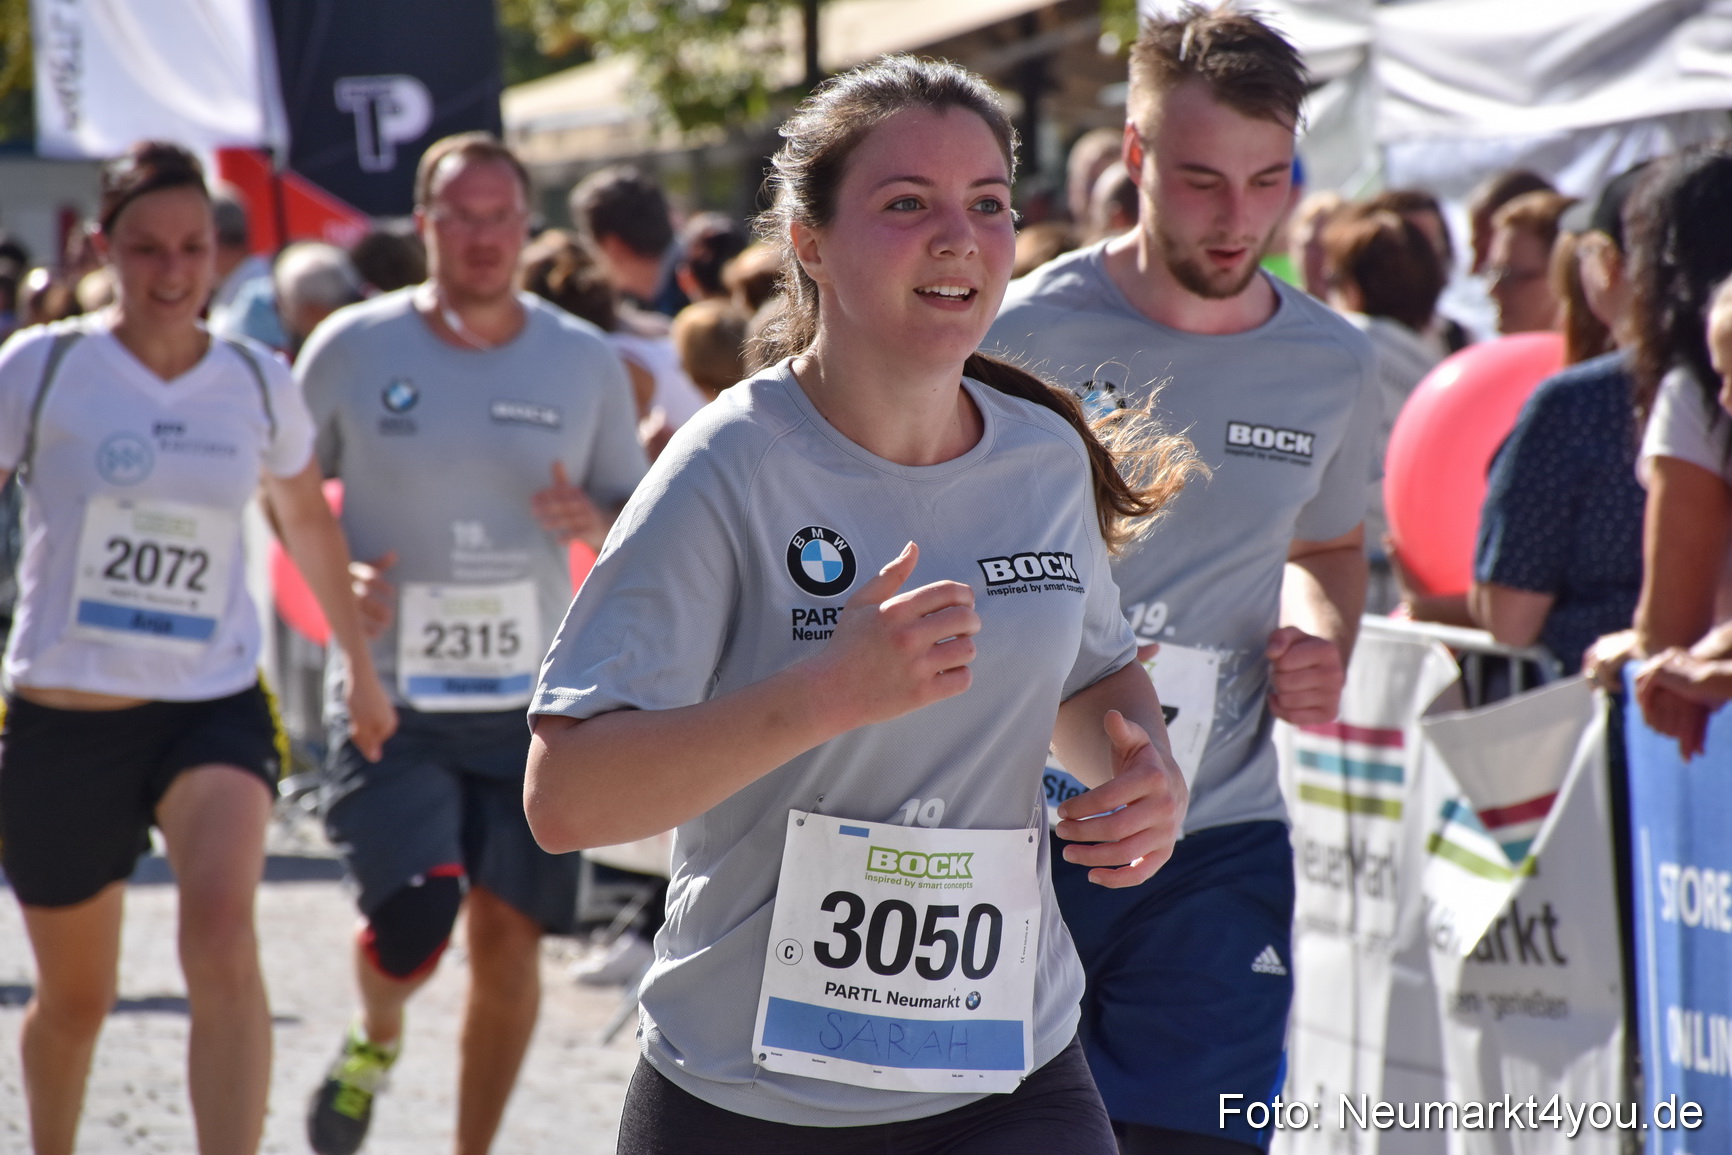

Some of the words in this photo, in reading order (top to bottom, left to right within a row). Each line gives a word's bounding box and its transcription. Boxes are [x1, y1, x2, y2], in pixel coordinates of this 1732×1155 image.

[1227, 421, 1314, 457] BOCK
[792, 527, 848, 551] BMW
[104, 536, 209, 593] 2072
[980, 552, 1080, 585] BOCK
[986, 584, 1029, 597] inspired
[1029, 583, 1042, 594] by
[1043, 582, 1067, 591] smart
[423, 620, 521, 660] 2315
[1043, 775, 1091, 803] Ste
[866, 845, 975, 880] BOCK
[864, 872, 902, 885] inspired
[904, 878, 916, 889] by
[917, 881, 943, 890] smart
[943, 881, 974, 891] concepts
[813, 890, 1003, 981] 3050
[824, 981, 882, 1004] PARTL
[886, 990, 961, 1009] Neumarkt
[818, 1011, 969, 1062] SARAH
